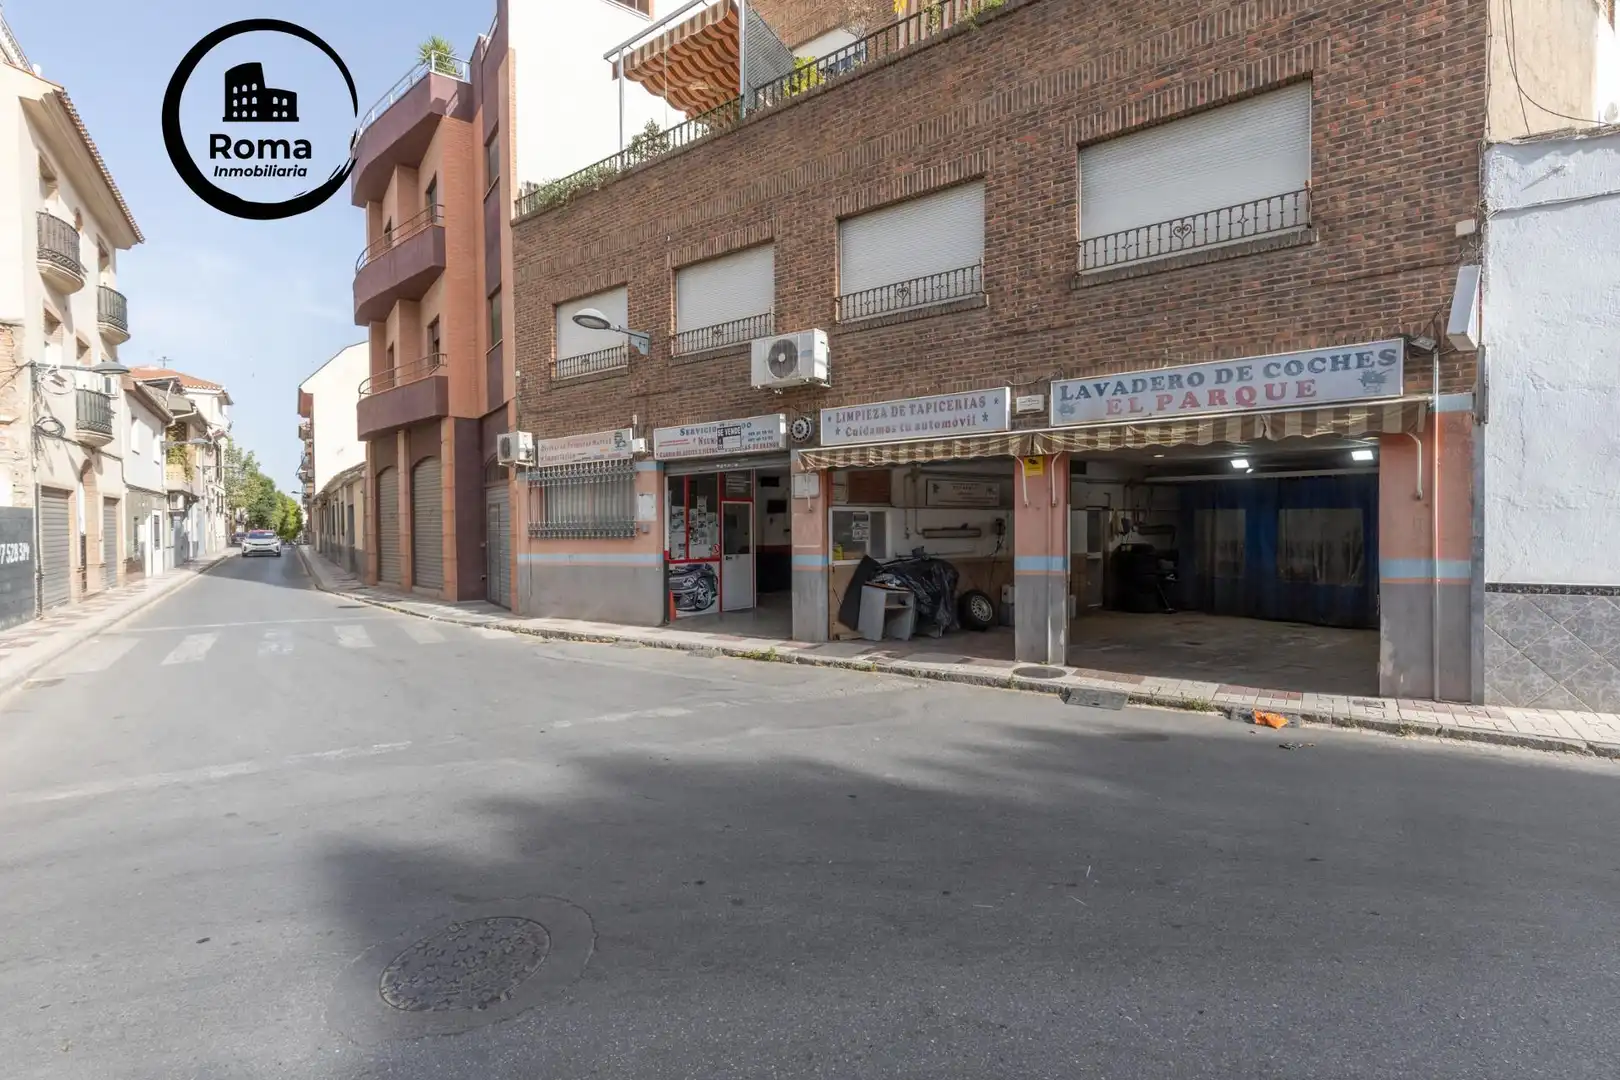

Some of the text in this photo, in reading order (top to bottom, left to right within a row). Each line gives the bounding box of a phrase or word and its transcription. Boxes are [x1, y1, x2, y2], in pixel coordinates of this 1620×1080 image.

[1059, 348, 1398, 401] LAVADERO DE COCHES
[835, 395, 987, 424] LIMPIEZA DE TAPICERIAS
[1106, 379, 1317, 416] EL PARQUE
[717, 428, 724, 437] SE
[725, 426, 741, 436] VENDE
[845, 423, 896, 437] Cuidamos
[900, 421, 912, 433] tu
